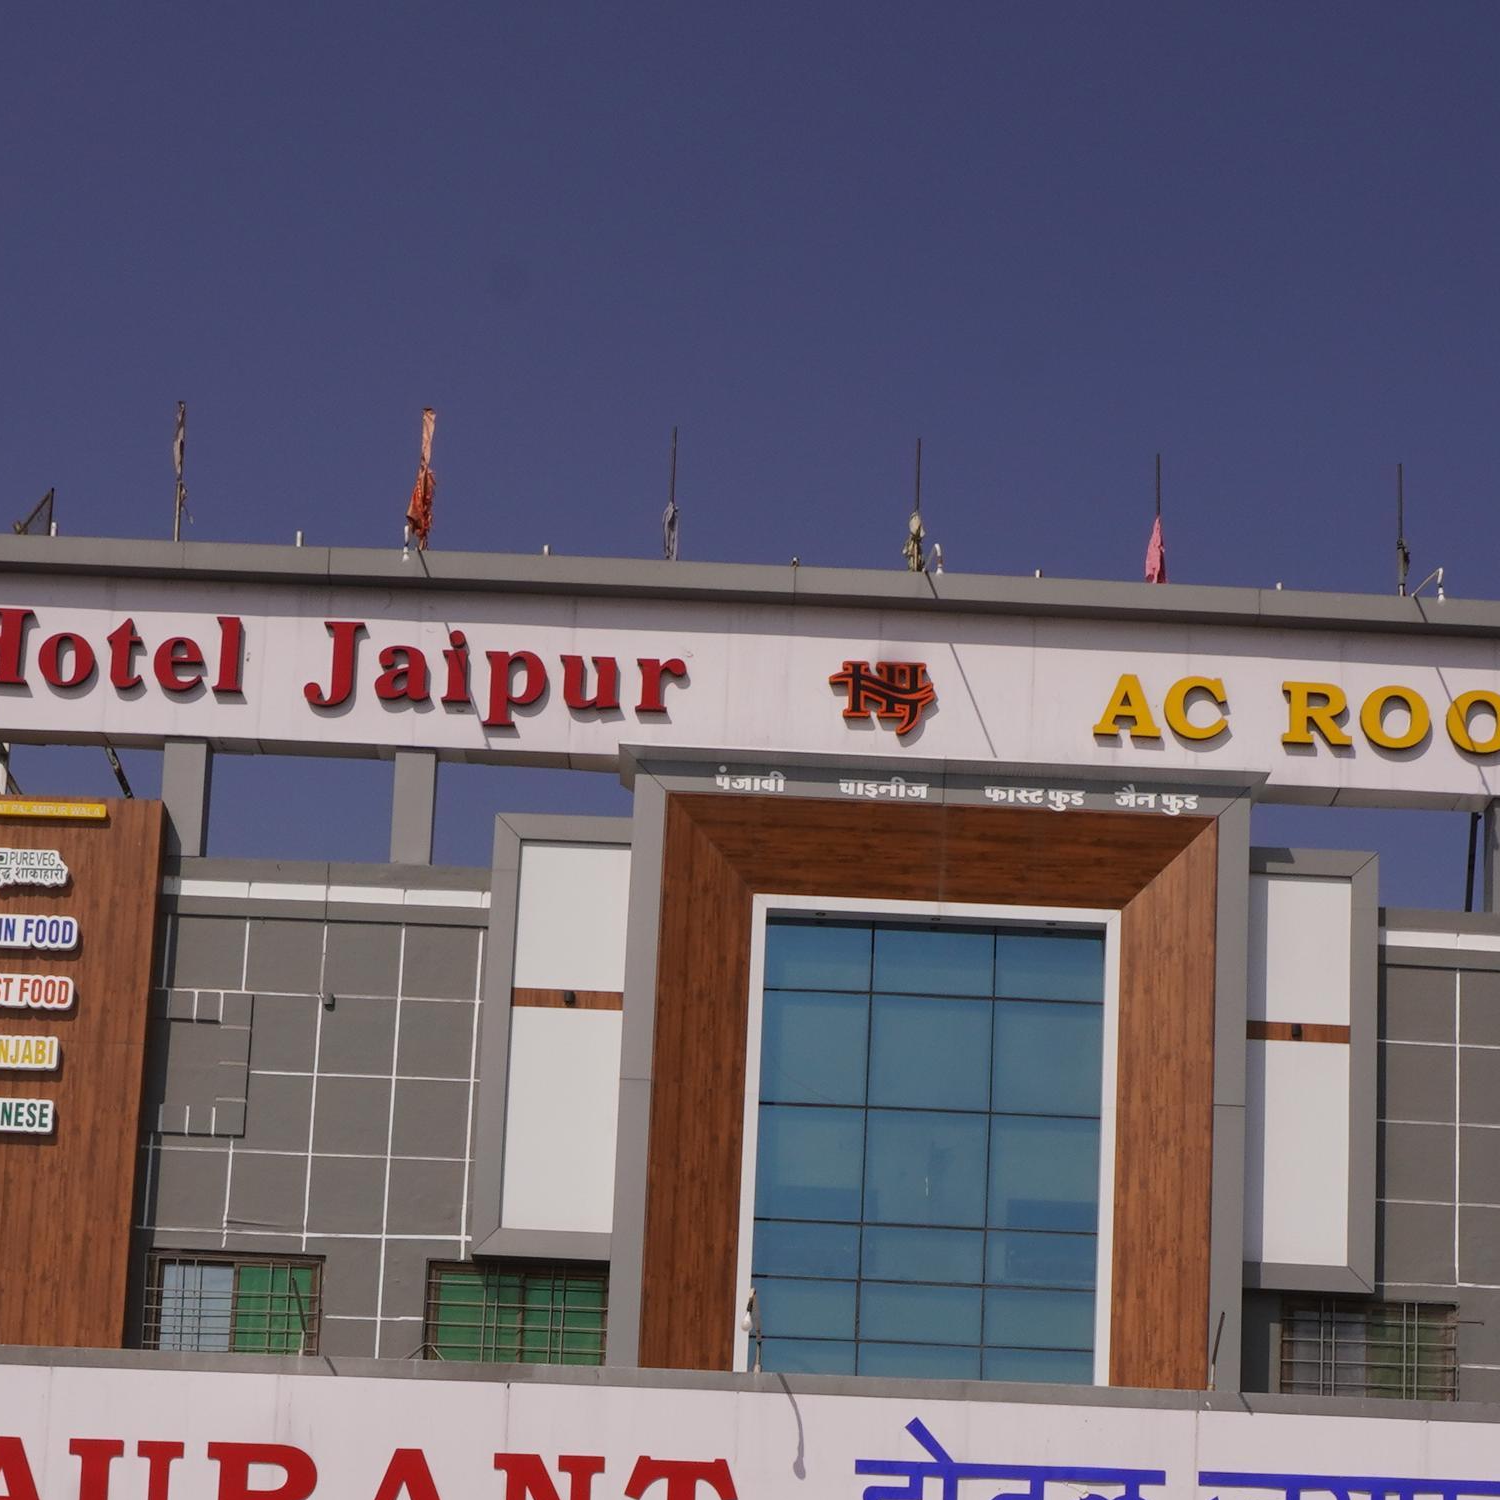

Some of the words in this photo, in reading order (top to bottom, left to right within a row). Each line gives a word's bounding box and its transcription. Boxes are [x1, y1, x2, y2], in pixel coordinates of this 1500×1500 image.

[304, 620, 688, 727] Jaipur
[1093, 673, 1229, 742] AC
[839, 777, 929, 799] चाइनीज
[984, 786, 1045, 804] फास्ट
[1048, 789, 1085, 811] फुड
[1114, 784, 1157, 808] जैन
[1160, 793, 1199, 816] फुड
[9, 852, 36, 867] PURE
[37, 853, 55, 867] VEG
[24, 918, 74, 944] FOOD
[19, 978, 70, 1004] FOOD
